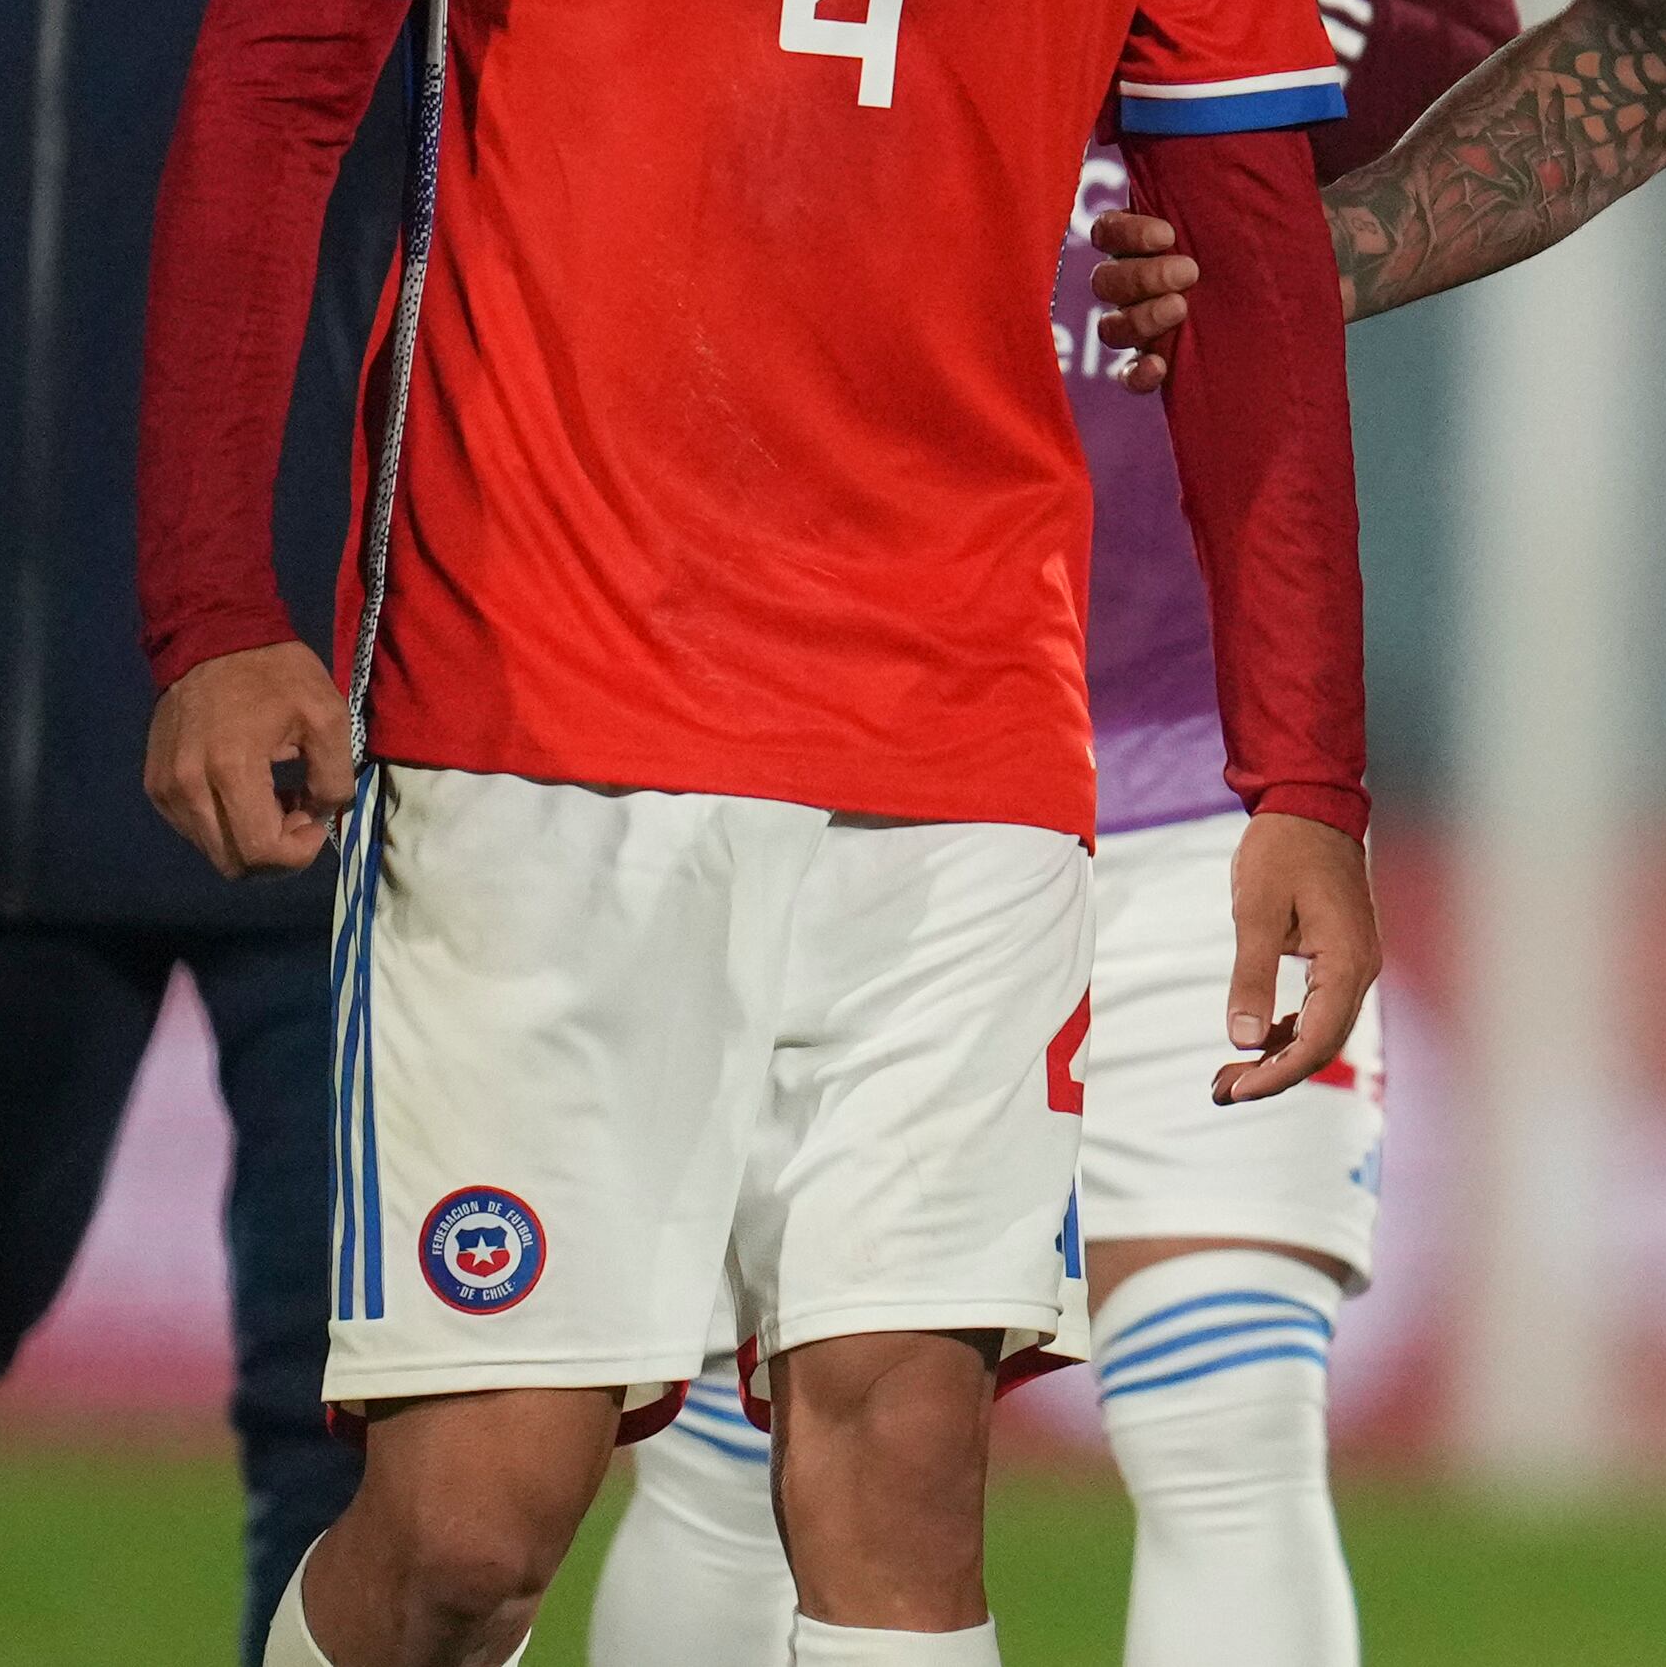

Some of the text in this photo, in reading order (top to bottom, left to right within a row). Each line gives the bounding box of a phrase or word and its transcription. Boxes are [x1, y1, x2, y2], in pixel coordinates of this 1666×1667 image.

[432, 1200, 534, 1255] FEDERACION DE FUTBOL
[459, 1281, 515, 1301] DE CHILE
